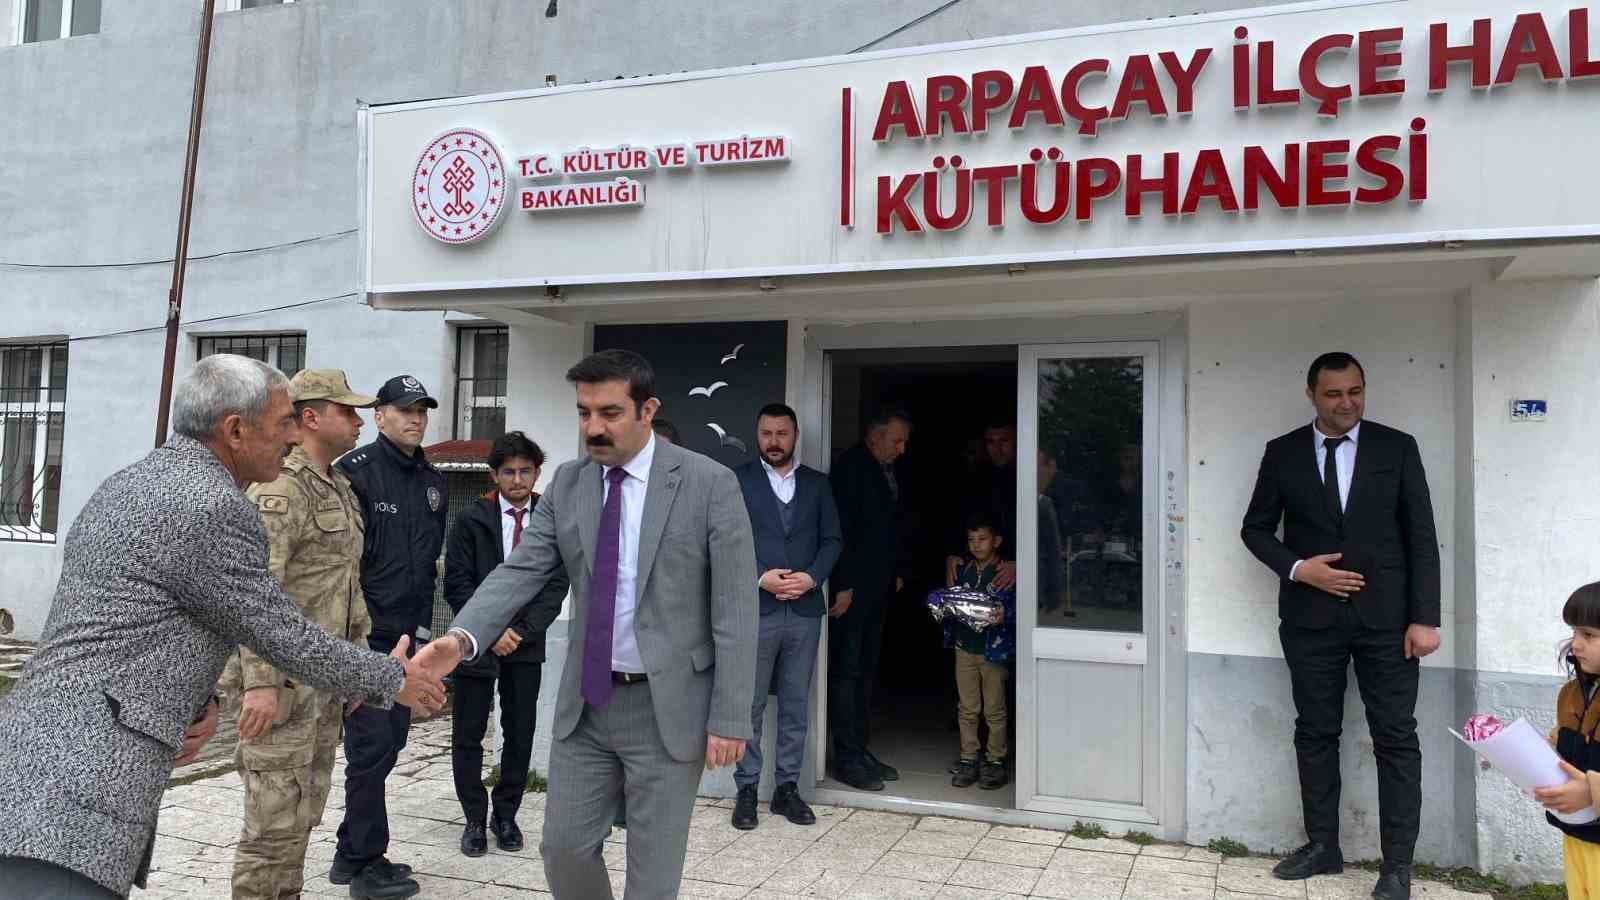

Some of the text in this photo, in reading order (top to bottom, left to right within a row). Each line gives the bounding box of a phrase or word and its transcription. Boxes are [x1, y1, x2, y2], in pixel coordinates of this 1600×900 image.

[872, 8, 1600, 141] ARPAÇAY İLÇE HAL
[519, 136, 785, 178] T.C. KÜLTÜR VE TURİZM
[521, 179, 638, 210] BAKANLIĞI
[876, 118, 1429, 234] KÜTÜPHANESİ
